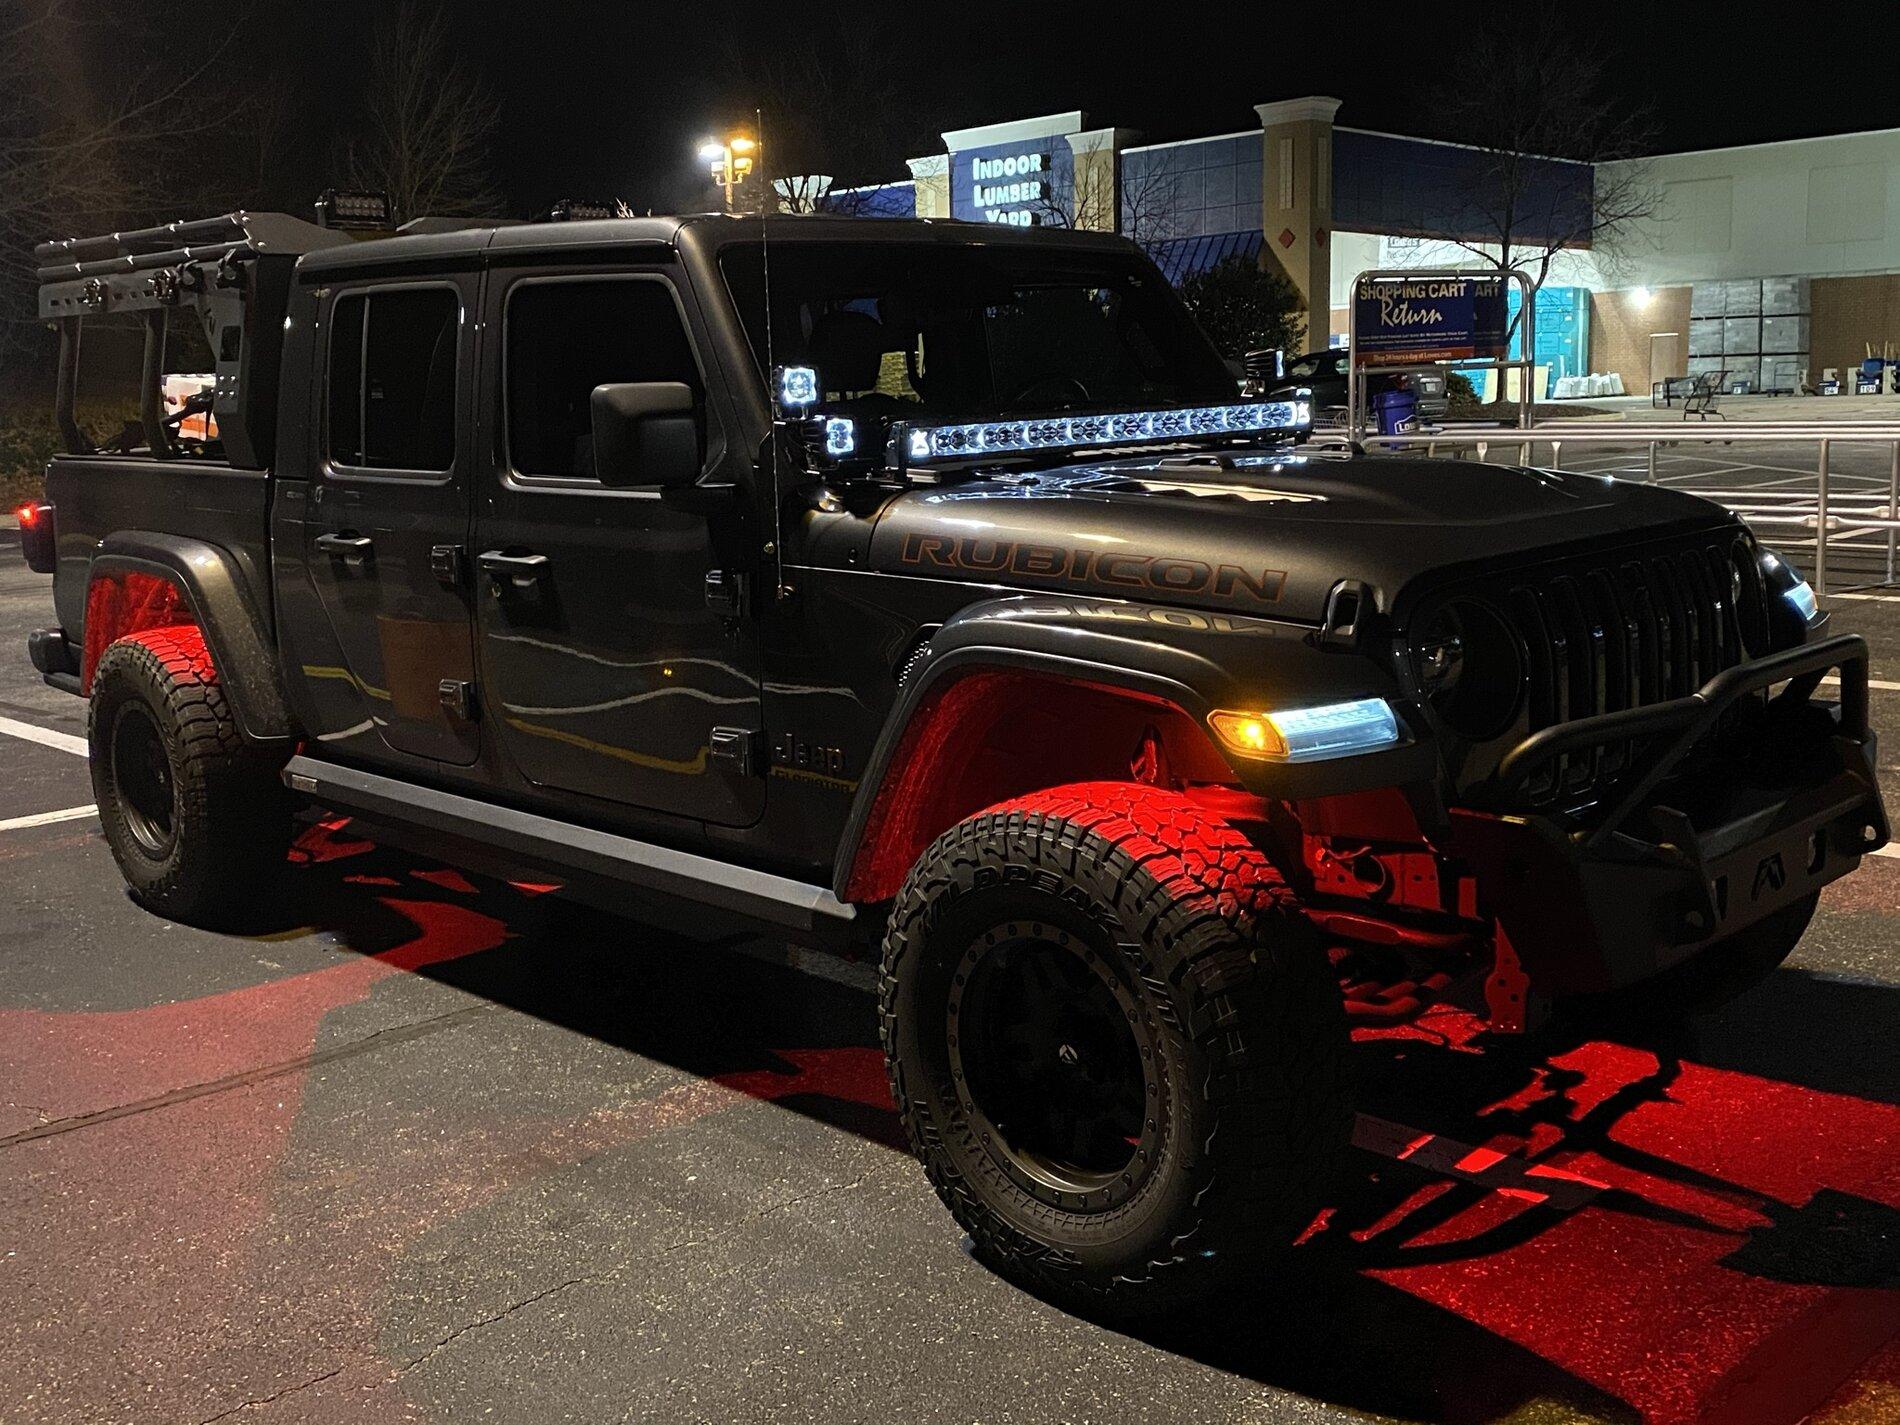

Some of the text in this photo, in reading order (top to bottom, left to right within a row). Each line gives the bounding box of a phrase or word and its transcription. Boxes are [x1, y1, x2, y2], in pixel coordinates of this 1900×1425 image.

[972, 153, 1042, 180] INDOOR
[973, 181, 1041, 208] LUMBER
[1360, 282, 1467, 300] SHOPPING CART
[1475, 284, 1500, 298] ART
[1380, 297, 1443, 327] Return
[902, 533, 1289, 602] RUBICON
